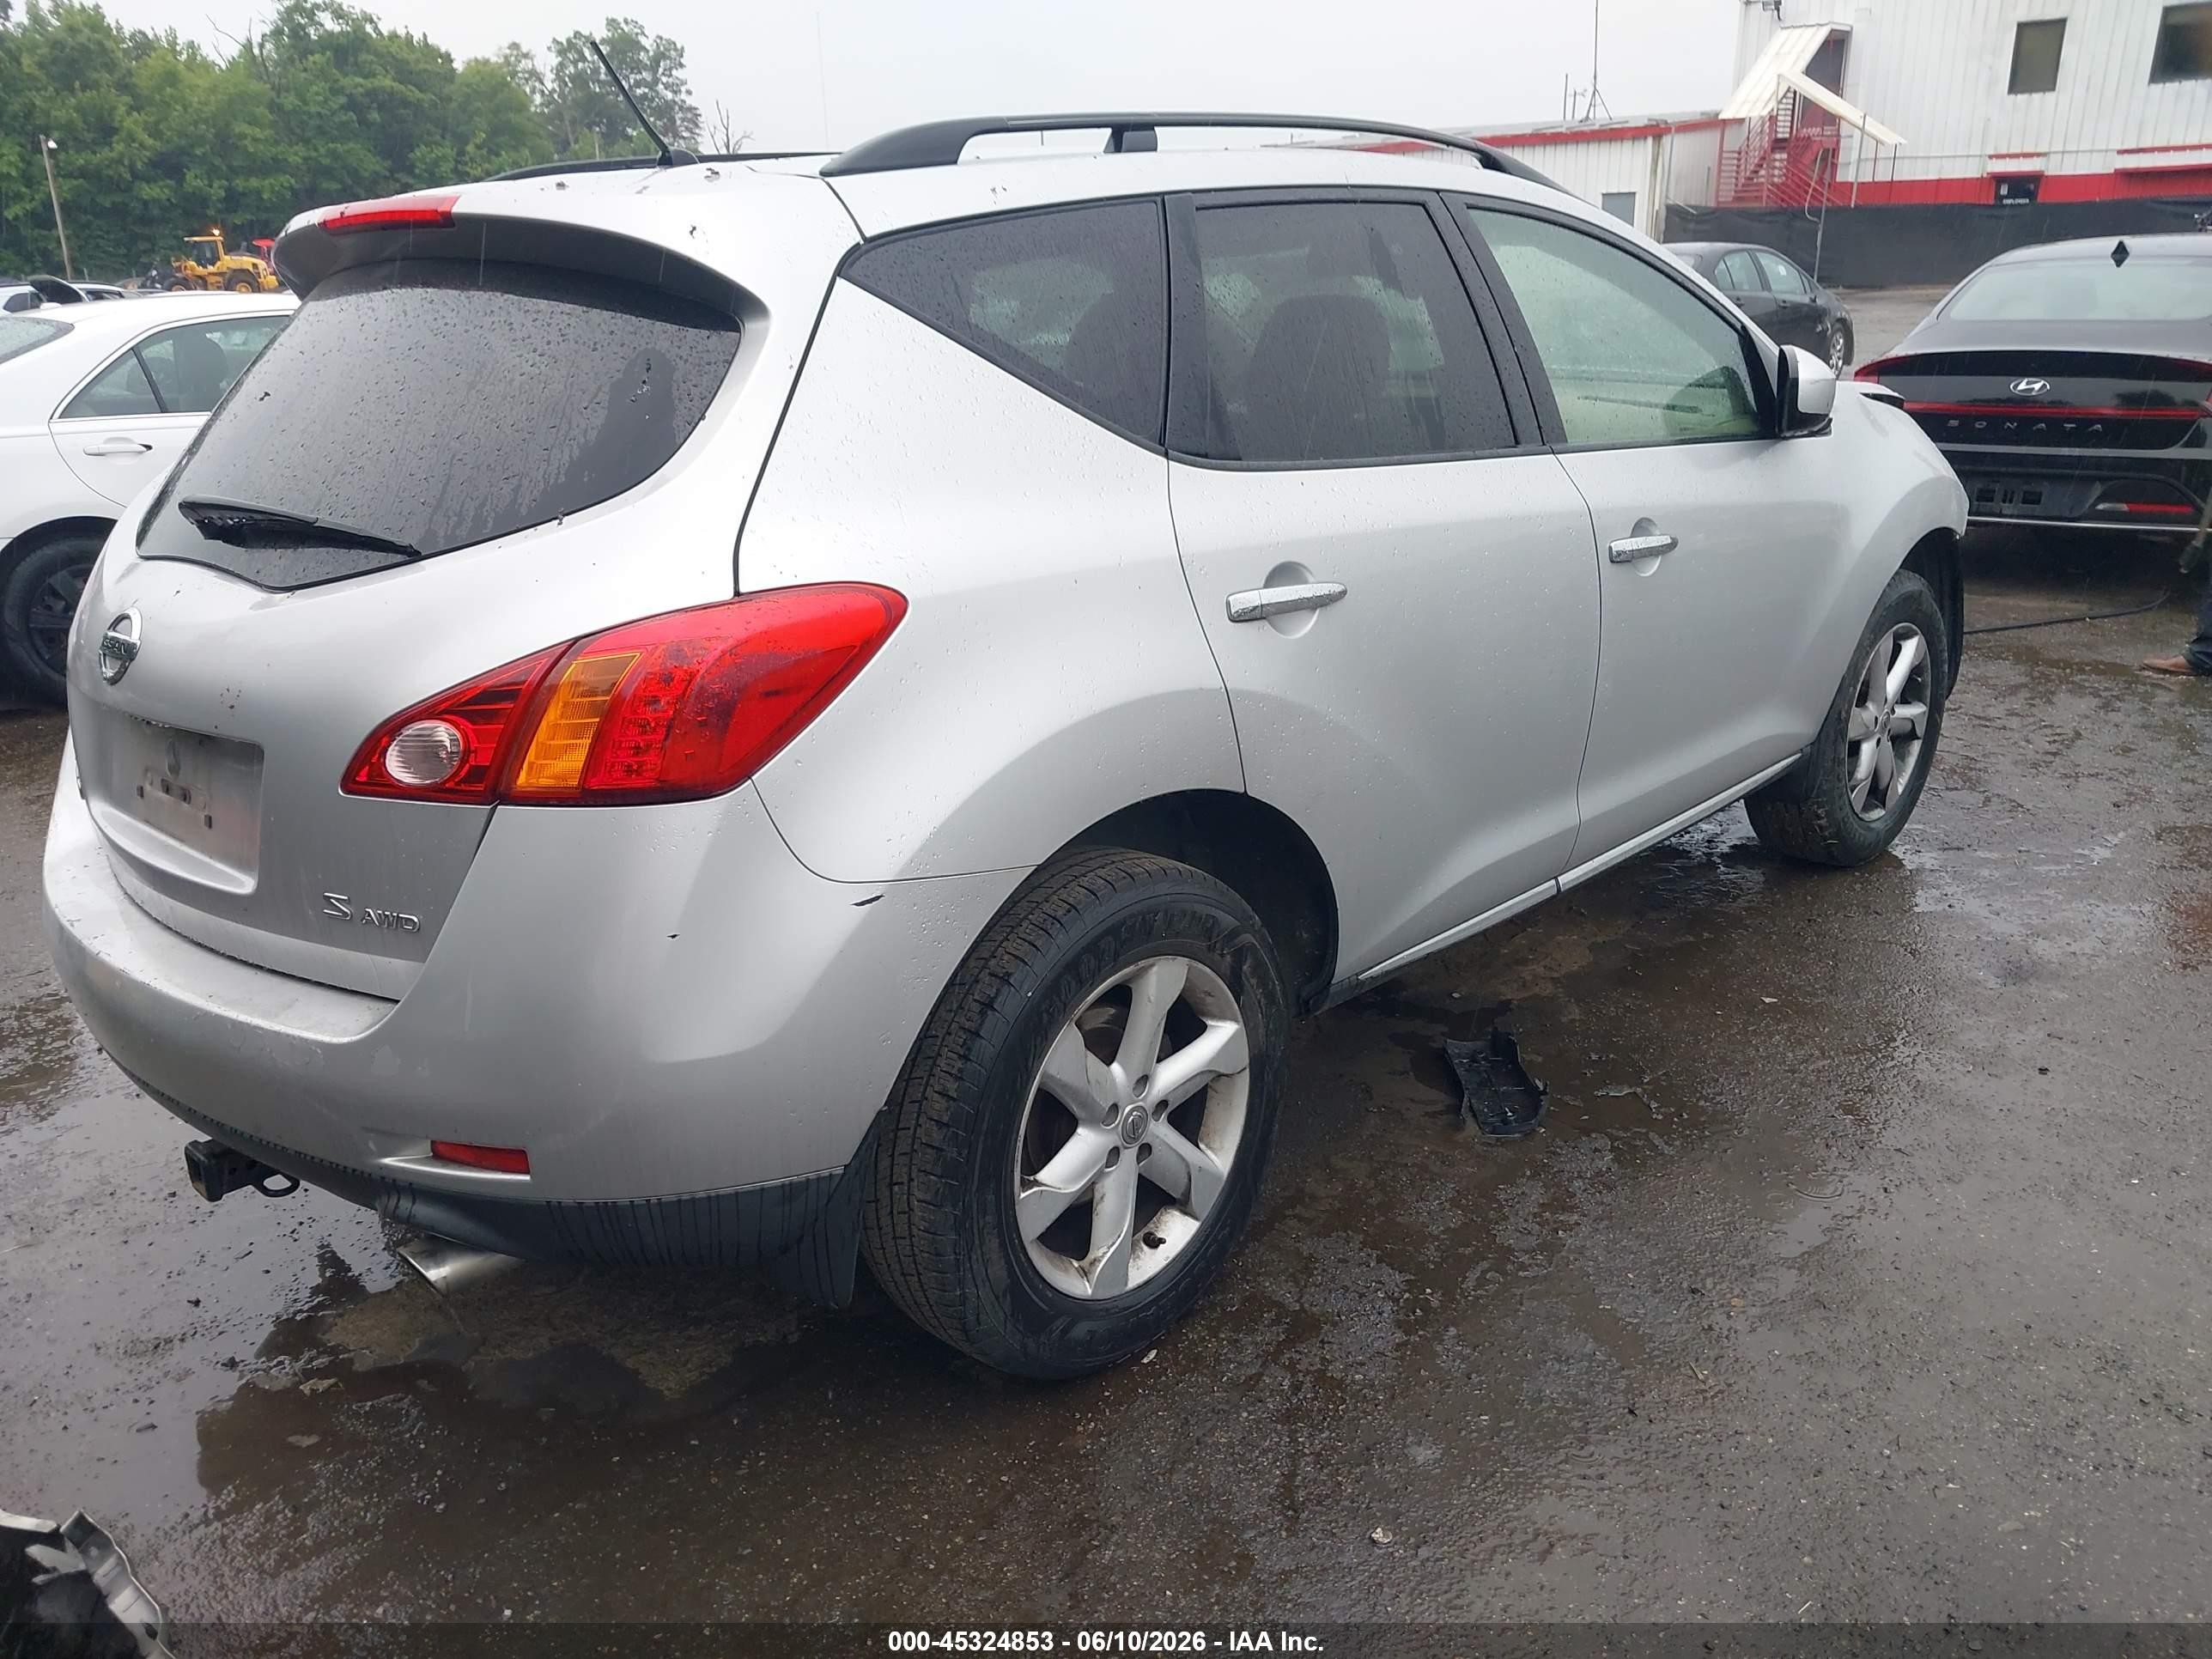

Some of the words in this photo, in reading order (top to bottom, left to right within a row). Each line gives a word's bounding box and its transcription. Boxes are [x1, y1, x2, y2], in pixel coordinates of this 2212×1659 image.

[1947, 418, 2103, 433] SONATA
[322, 891, 353, 921] S
[361, 907, 420, 933] AWD
